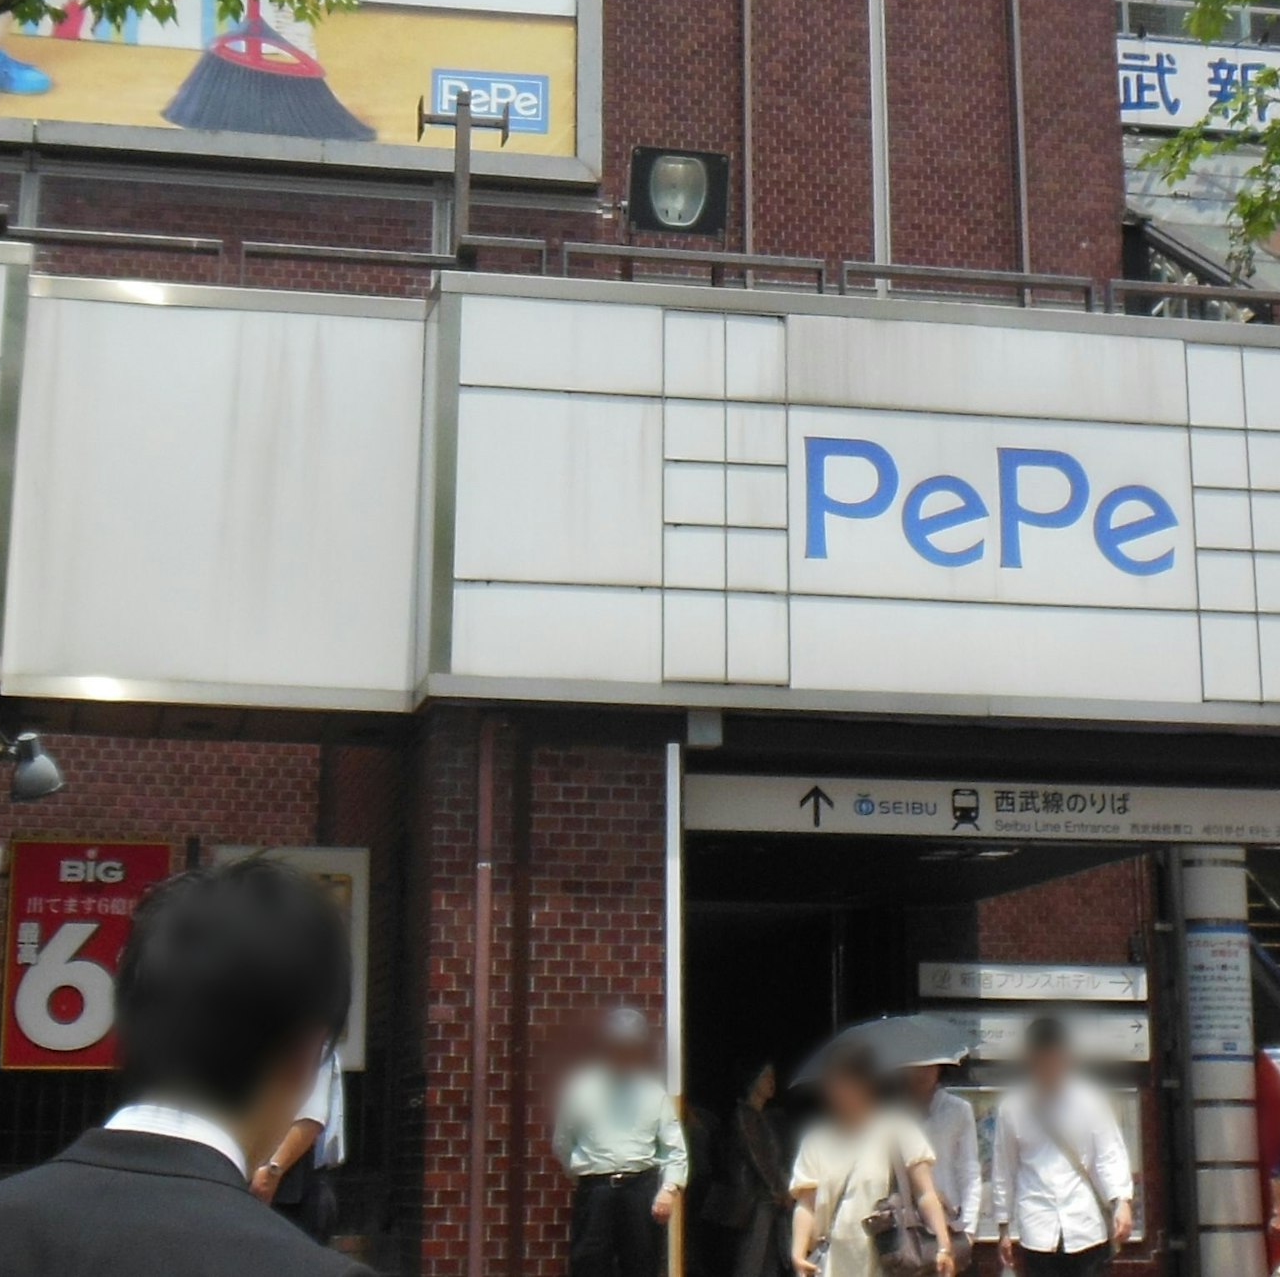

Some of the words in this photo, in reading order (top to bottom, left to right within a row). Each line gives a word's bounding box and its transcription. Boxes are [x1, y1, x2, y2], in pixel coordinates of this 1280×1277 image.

[803, 435, 1179, 576] PePe
[877, 800, 938, 817] SEIBU
[994, 790, 1131, 816] 西武線のりば
[995, 820, 1032, 833] Seibu
[1034, 821, 1061, 833] Line
[1064, 821, 1120, 834] Entrance
[58, 860, 125, 883] BIG
[15, 922, 117, 1052] 6
